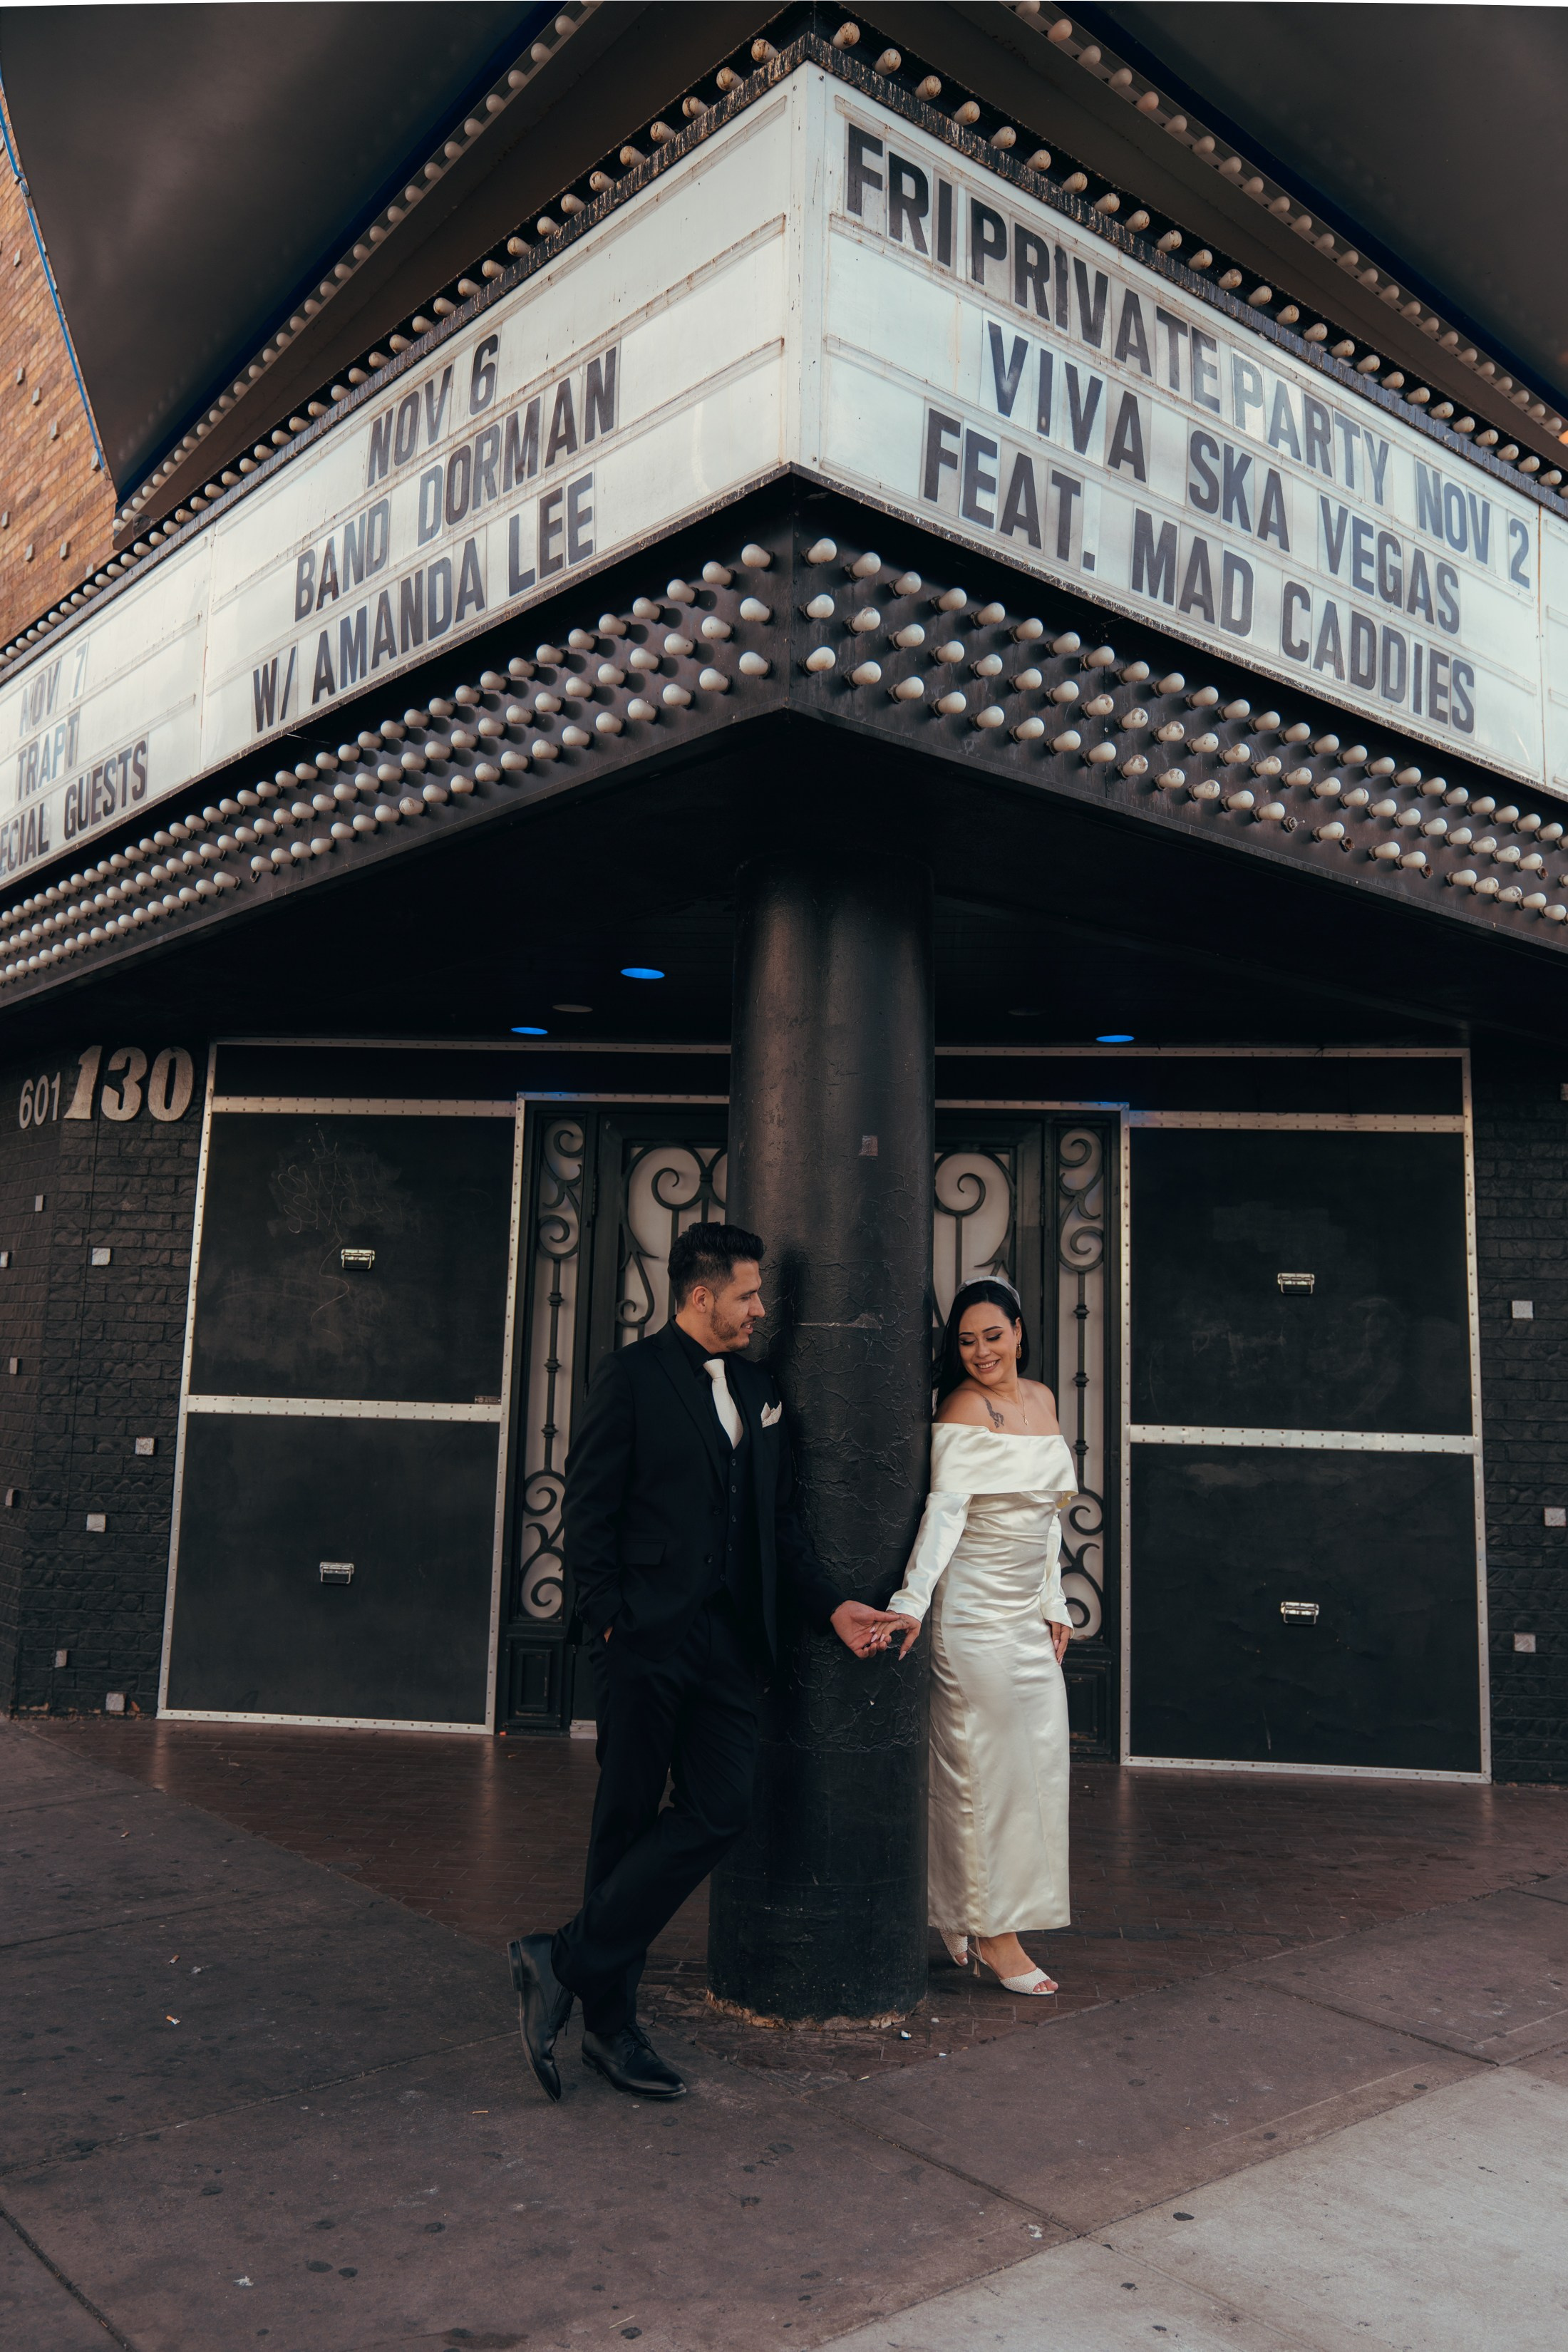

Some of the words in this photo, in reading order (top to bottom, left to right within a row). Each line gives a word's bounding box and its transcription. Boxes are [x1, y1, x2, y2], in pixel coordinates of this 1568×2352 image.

[367, 366, 451, 488] NOV
[470, 334, 497, 416] 6
[294, 499, 388, 621] BAND
[418, 346, 617, 547] DORMAN
[988, 320, 1147, 483] VIVA
[1189, 430, 1291, 553] SKA
[1320, 495, 1460, 634] VEGAS
[1415, 462, 1491, 565] NOV
[1509, 517, 1530, 589] 2
[253, 646, 296, 733] W/
[311, 537, 485, 704] AMANDA
[509, 472, 593, 597] LEE
[924, 408, 1096, 571] FEAT.
[1132, 509, 1254, 637] MAD
[1282, 582, 1475, 734] CADDIES
[19, 660, 61, 738] NOV
[73, 642, 88, 698] 7
[18, 711, 80, 801] TRAPT
[64, 740, 147, 840] GUESTS
[19, 1072, 61, 1129] 601
[63, 1045, 194, 1122] 130
